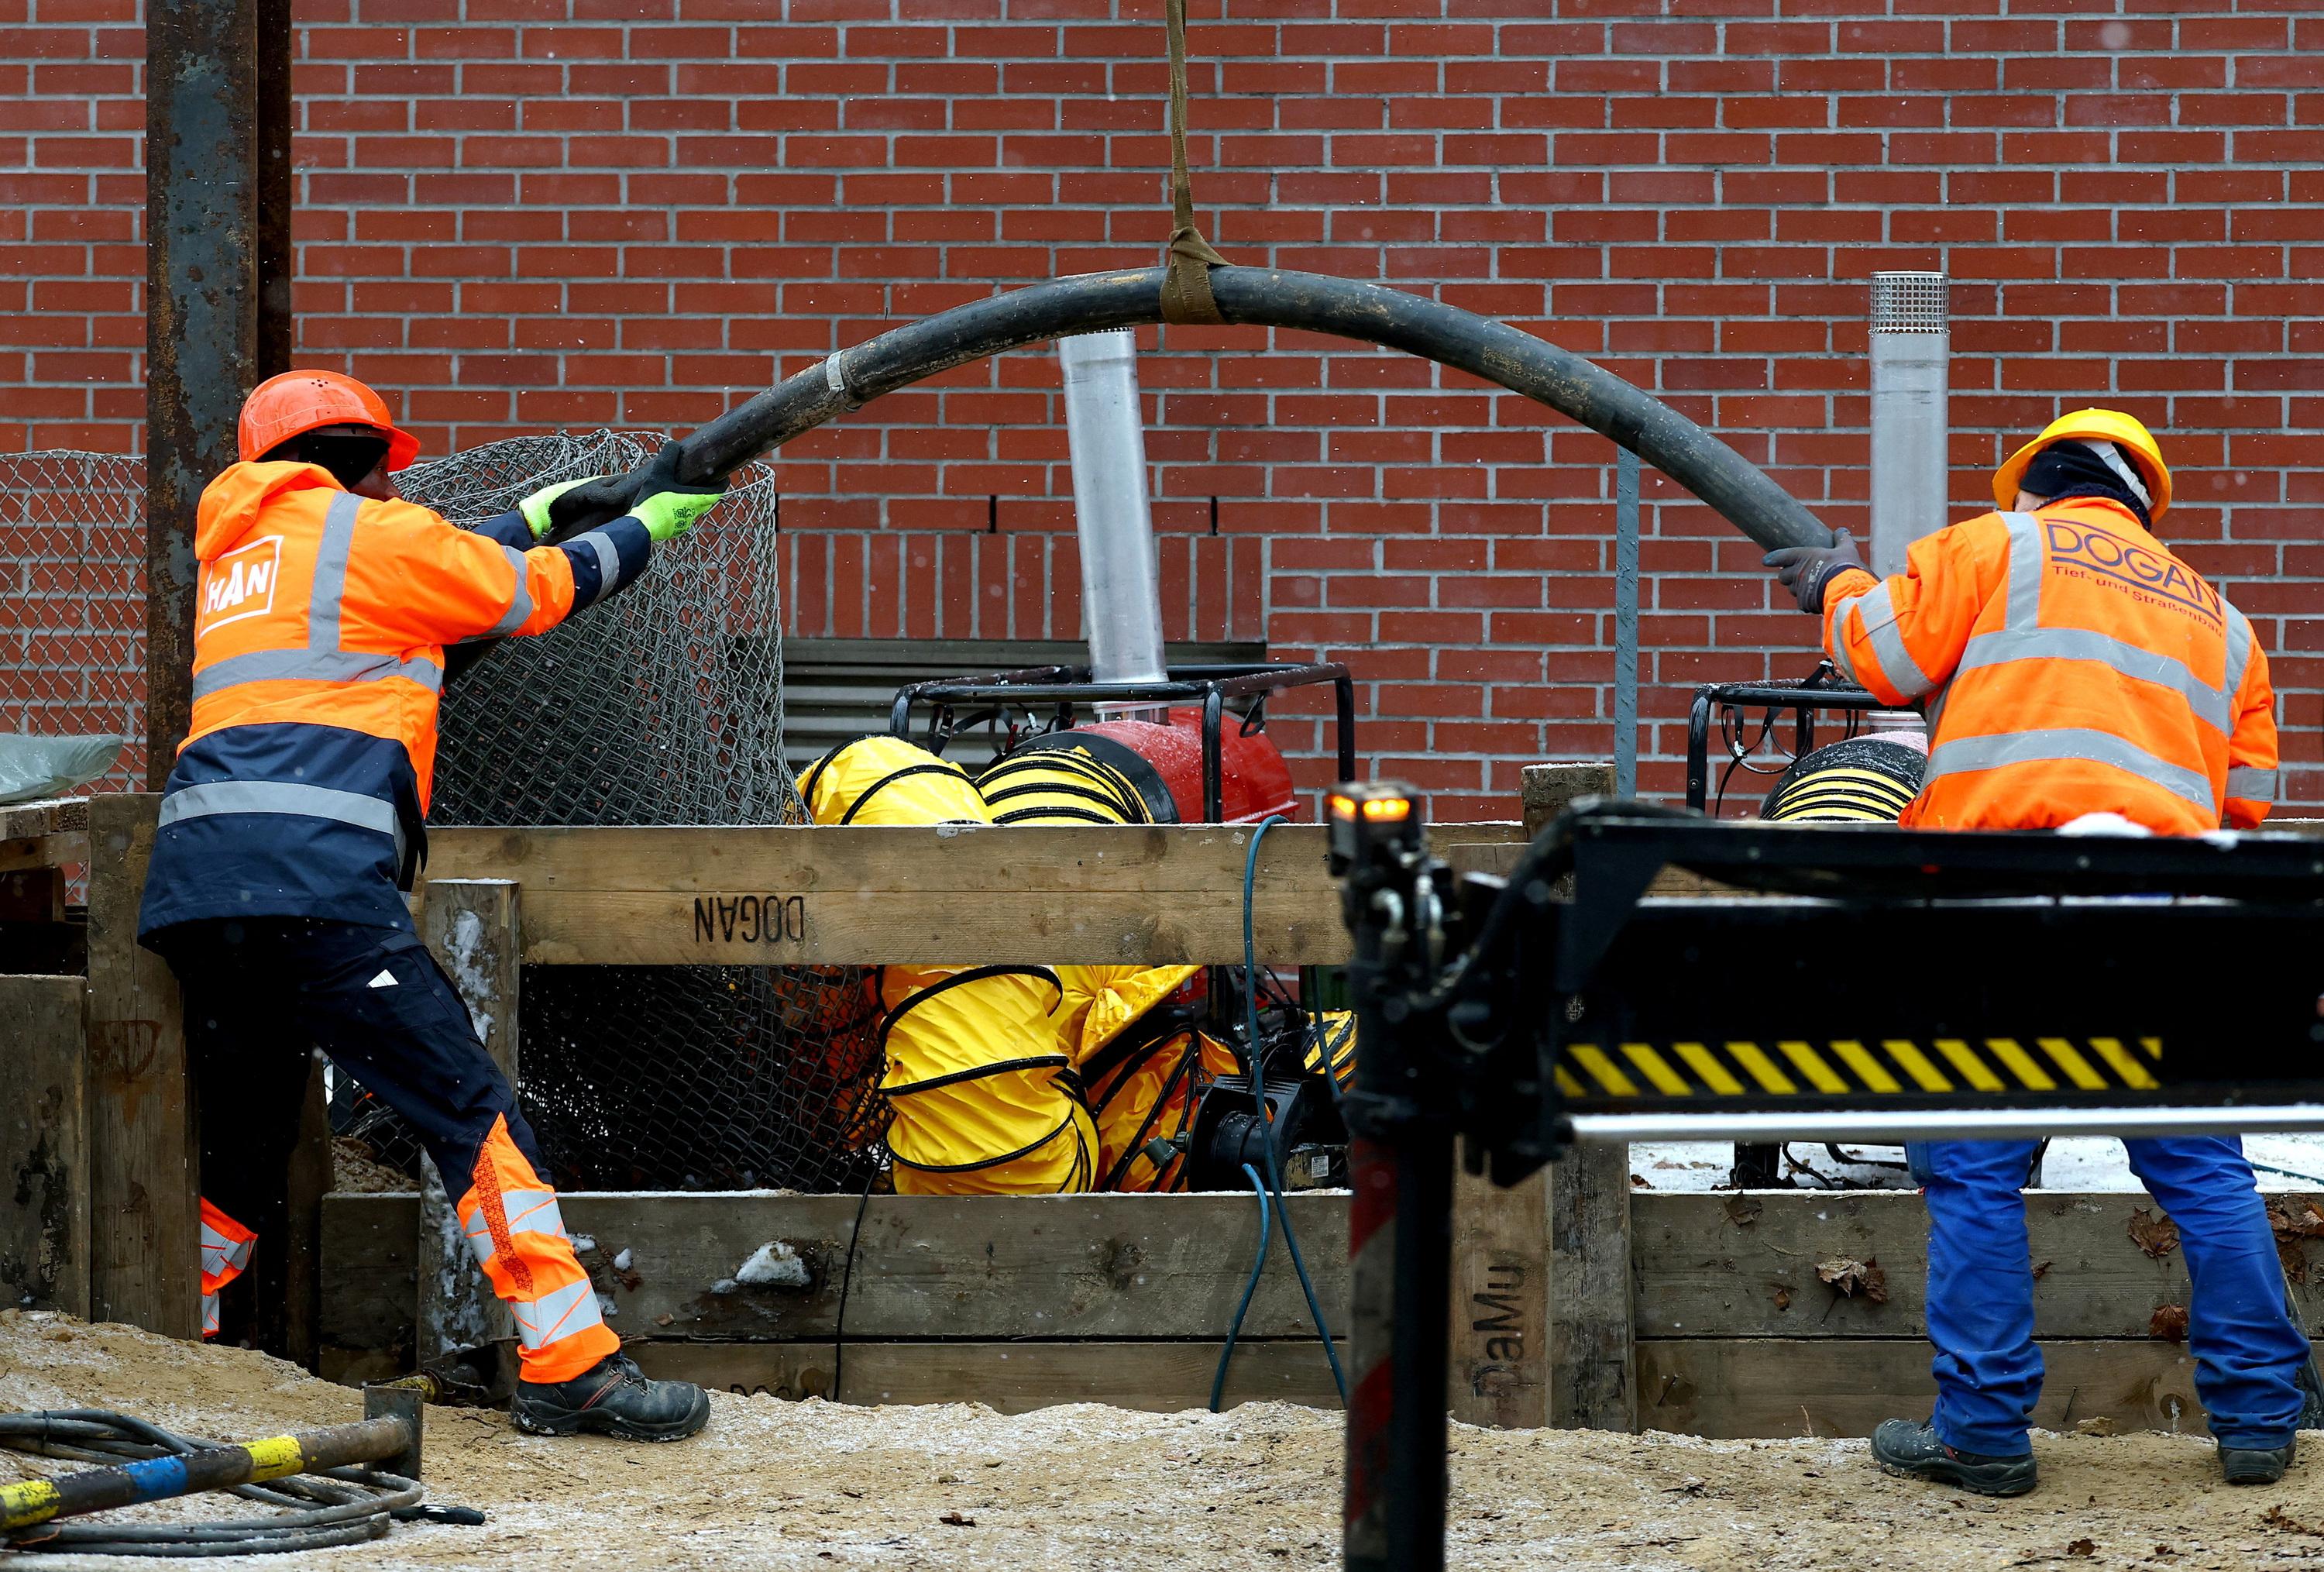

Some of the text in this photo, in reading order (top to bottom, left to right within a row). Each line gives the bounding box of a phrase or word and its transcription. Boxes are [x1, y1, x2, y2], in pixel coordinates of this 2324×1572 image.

[2047, 524, 2222, 616] DOGAN
[2053, 566, 2222, 638] Tief- und Straßenbau
[695, 896, 804, 943] DOGAN
